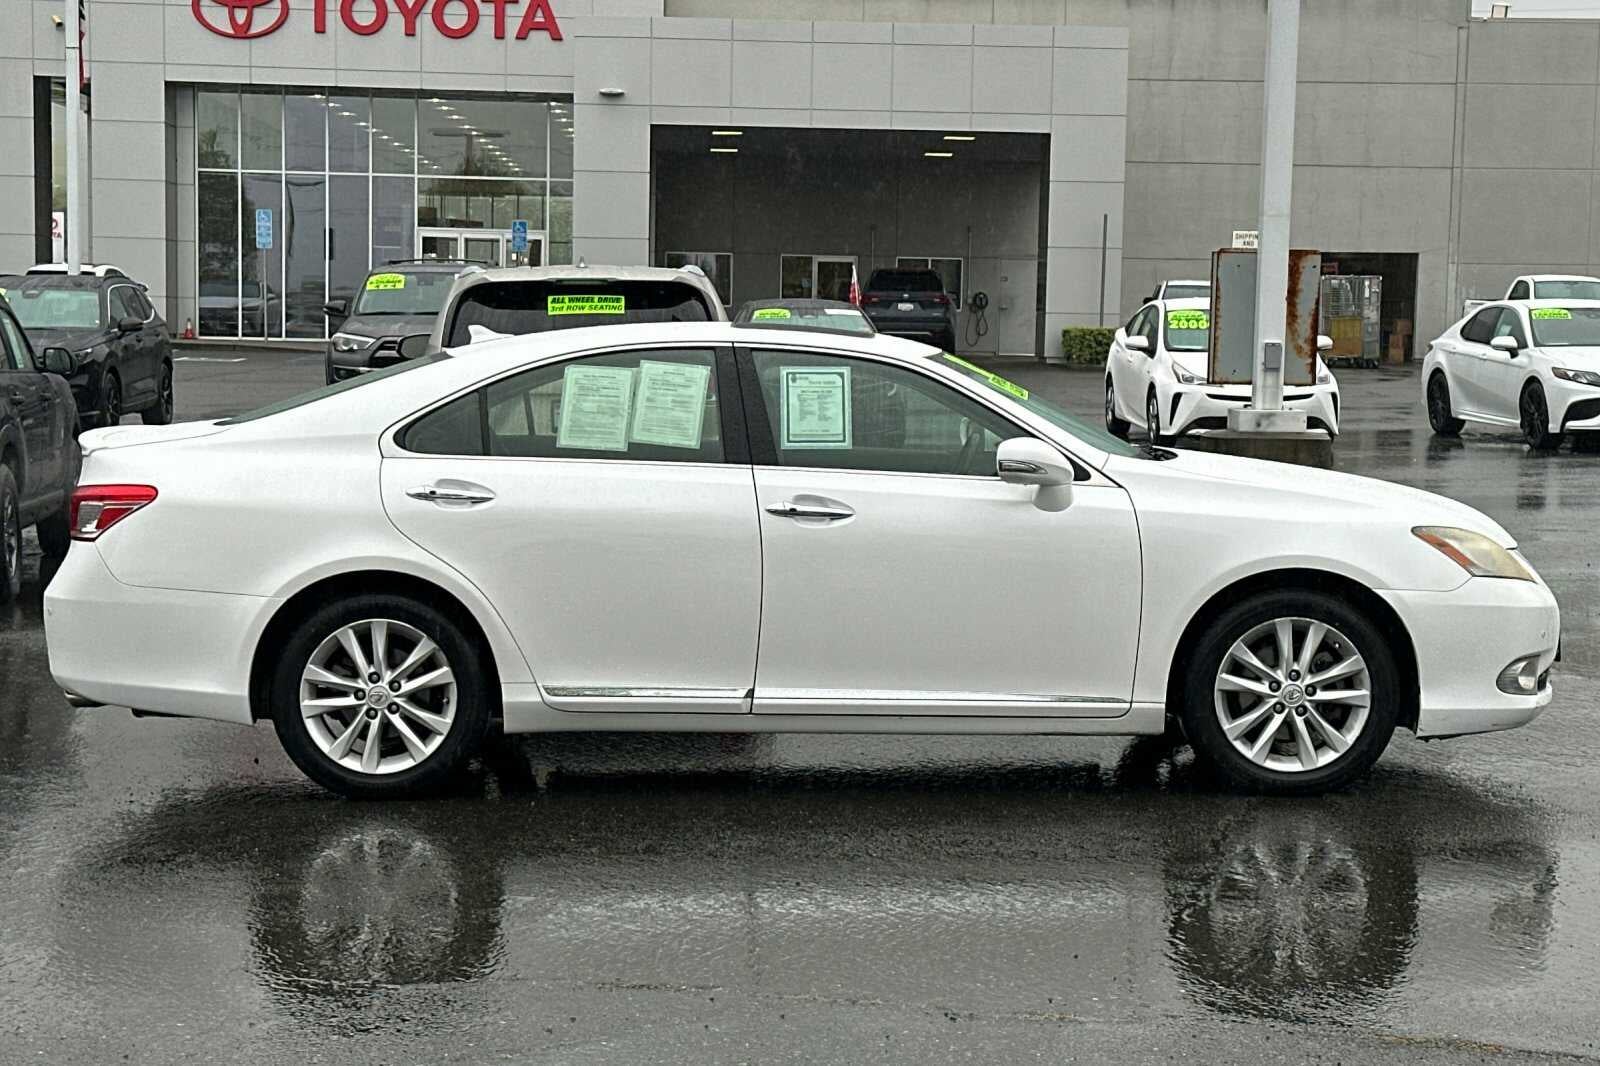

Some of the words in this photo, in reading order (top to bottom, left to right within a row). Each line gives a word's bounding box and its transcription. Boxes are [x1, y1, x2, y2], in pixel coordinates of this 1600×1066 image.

[314, 0, 563, 41] TOYOTA
[551, 296, 567, 304] ALL
[568, 296, 595, 304] WHEEL
[597, 296, 623, 304] DRIVE
[550, 305, 565, 313] 3rd
